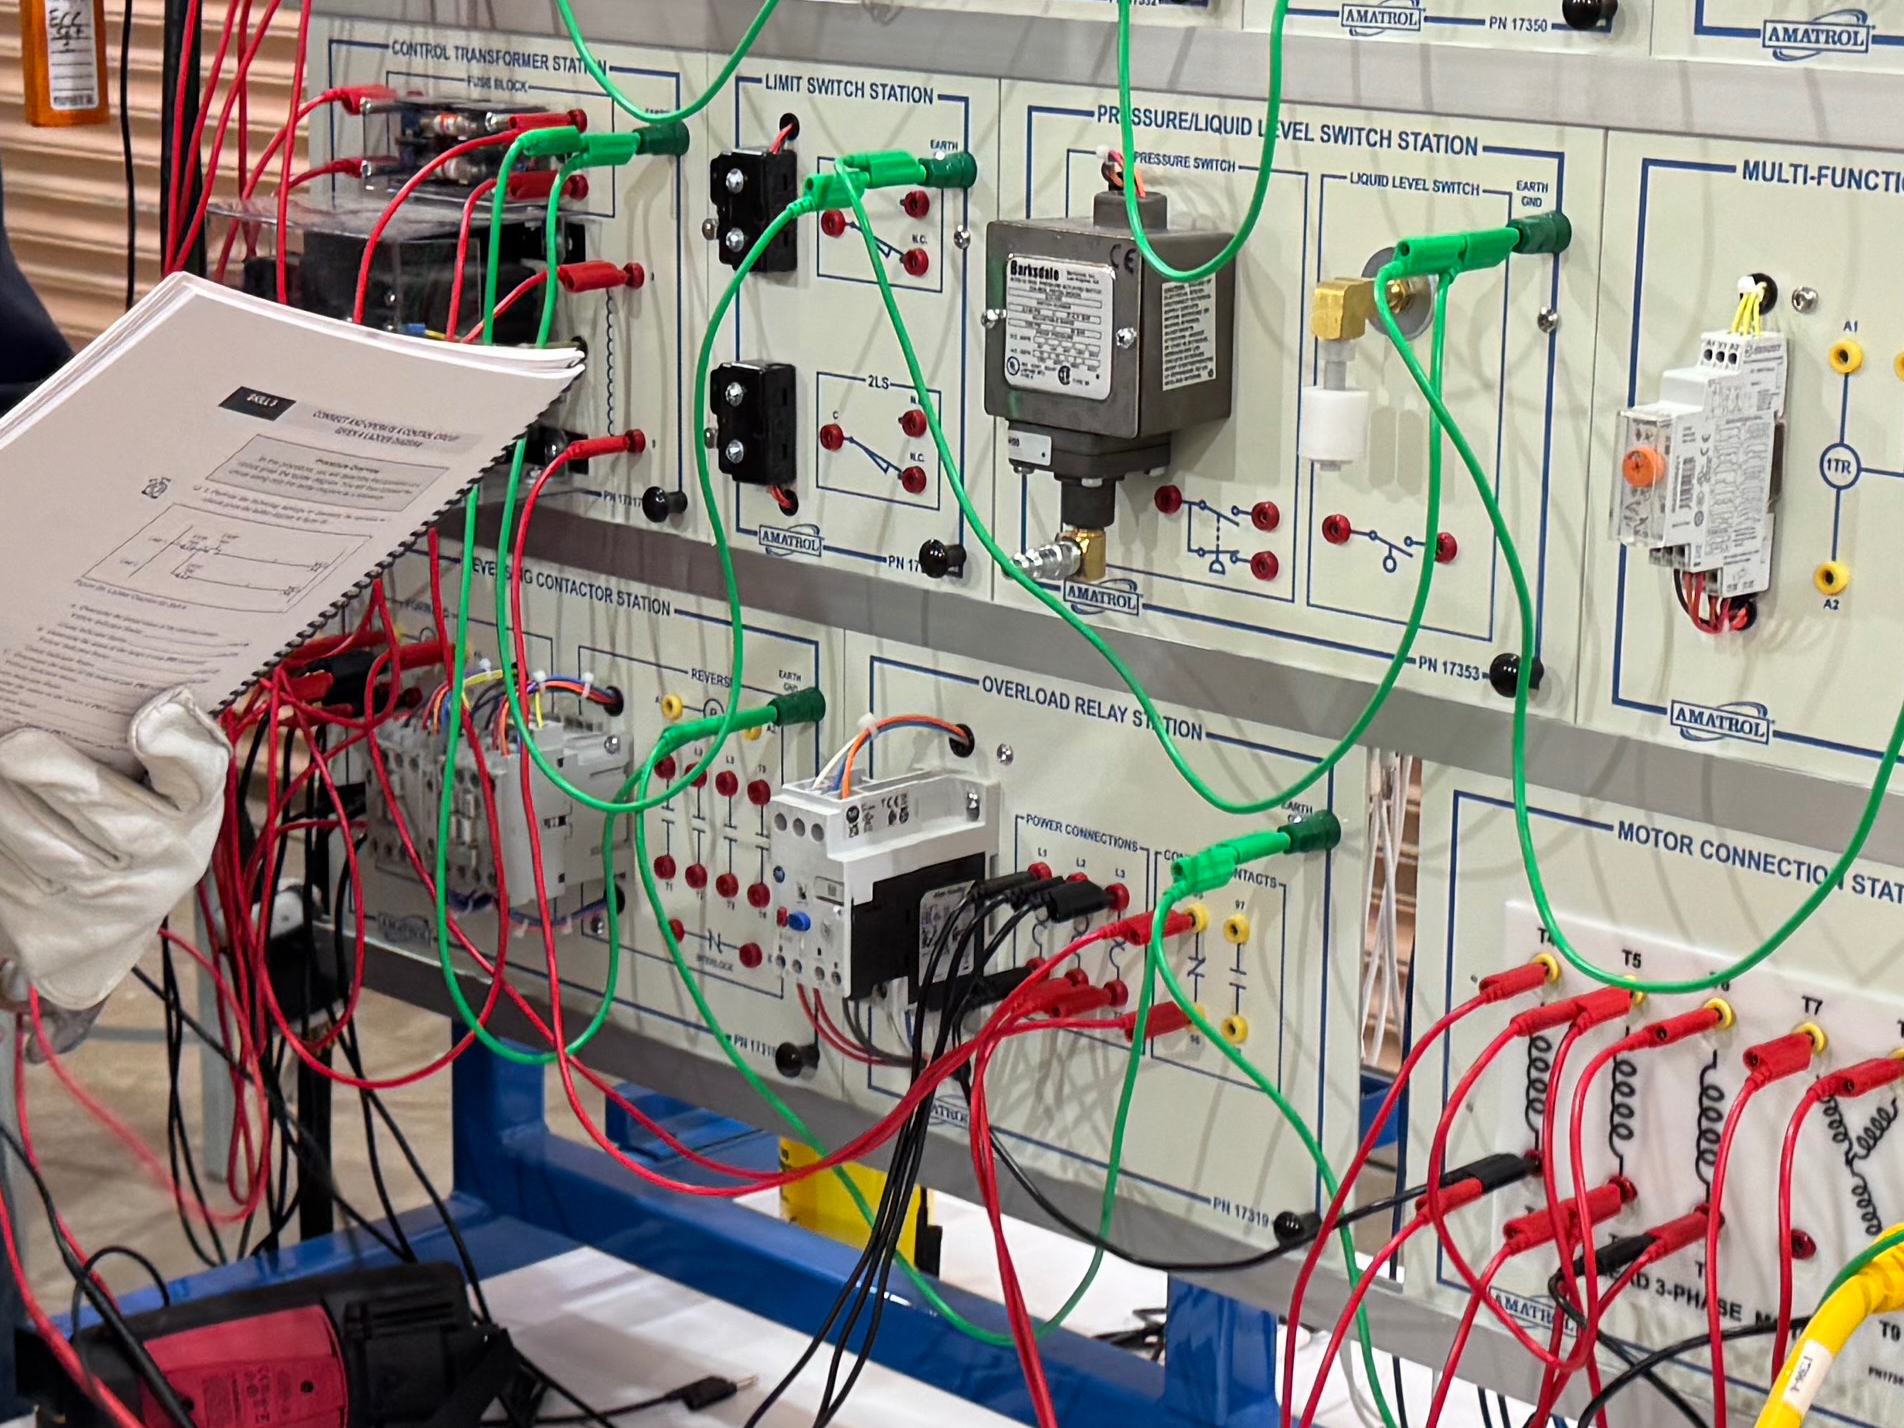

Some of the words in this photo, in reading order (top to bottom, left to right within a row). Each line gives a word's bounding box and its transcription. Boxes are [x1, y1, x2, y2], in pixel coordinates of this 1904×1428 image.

[1345, 9, 1417, 27] AMATROL
[1489, 16, 1507, 31] PN
[1511, 18, 1548, 33] 17350
[1767, 25, 1866, 47] AMATROL
[392, 40, 451, 61] CONTROL
[454, 47, 550, 70] TRANSFORMER
[493, 78, 528, 93] BLOCK
[765, 73, 803, 94] LIMIT
[807, 77, 866, 99] SWITCH
[869, 83, 934, 105] STATION
[1096, 104, 1253, 137] PRSSURE/LIQUID
[1320, 124, 1392, 149] SWITCH
[1397, 131, 1479, 157] STATION
[1133, 151, 1191, 170] PRESSURE
[1193, 158, 1236, 173] SWITCH
[1350, 172, 1389, 188] LIQUID
[1392, 176, 1429, 192] LEVEL
[1432, 180, 1480, 196] SWITCH
[1516, 180, 1549, 194] EARTH
[1521, 196, 1542, 208] GND
[1010, 260, 1060, 282] Barksdale
[1843, 321, 1858, 333] A1
[867, 376, 890, 389] 2LS
[1826, 458, 1852, 475] 1TR
[603, 491, 616, 501] PN
[762, 530, 820, 552] AMATROL
[888, 555, 904, 570] PN
[536, 570, 614, 605] CONTACTOR
[616, 591, 671, 617] STATION
[1067, 584, 1138, 612] AMATROL
[1823, 599, 1840, 611] A2
[1418, 657, 1437, 673] PN
[1442, 661, 1481, 681] 17353
[982, 676, 1071, 711] OVERLOAD
[1074, 697, 1128, 724] RELAY
[1132, 710, 1203, 741] STTION
[1676, 706, 1765, 738] AMATROL
[1026, 814, 1063, 832] POWER
[1065, 824, 1139, 853] CONNECTIONS
[1617, 819, 1694, 856] MOTOR
[1233, 868, 1277, 888] NTACTS
[1621, 949, 1642, 969] T5
[1802, 995, 1822, 1016] T7
[1213, 1195, 1231, 1215] PN
[1235, 1204, 1270, 1227] 17319
[1879, 1320, 1902, 1342] T9
